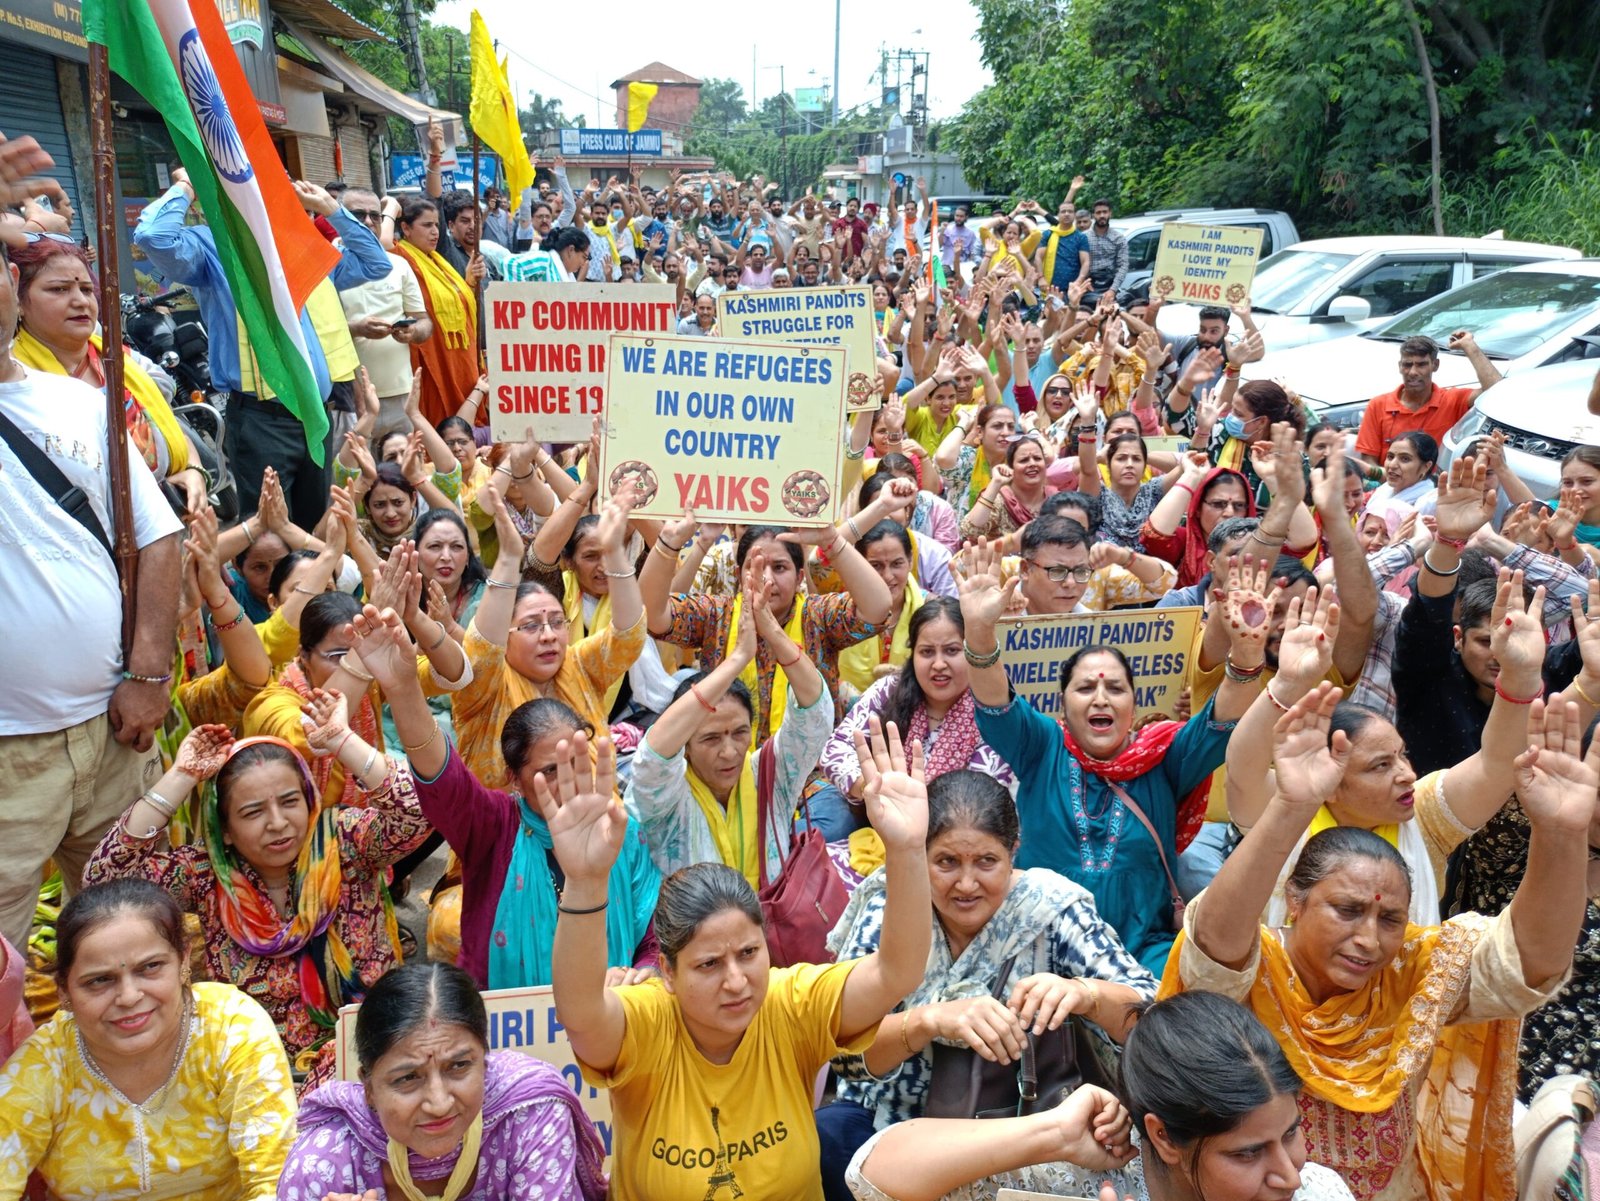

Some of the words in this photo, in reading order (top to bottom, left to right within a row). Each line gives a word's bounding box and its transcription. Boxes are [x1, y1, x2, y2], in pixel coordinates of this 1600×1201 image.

[25, 17, 63, 40] EXHIBITION
[580, 134, 603, 151] PRESS
[604, 134, 624, 151] CLUB
[624, 134, 634, 151] OF
[635, 134, 661, 152] JAMMU
[396, 169, 416, 187] OFFICE
[414, 165, 424, 177] OF
[465, 167, 493, 187] MAAGER
[1201, 229, 1206, 239] I
[1207, 231, 1222, 240] AM
[1167, 240, 1213, 252] KASHMIRI
[1214, 243, 1255, 256] PANDITS
[1182, 254, 1187, 263] I
[1188, 254, 1213, 266] LOVE
[1216, 257, 1232, 267] MY
[1184, 267, 1227, 280] IDENTITY
[1181, 281, 1221, 300] YAIKS
[726, 296, 800, 315] KASHMIRI
[805, 293, 866, 310] PANDITS
[493, 301, 526, 330] KP
[742, 317, 822, 336] STRUGGLE
[826, 315, 854, 330] FOR
[501, 344, 582, 372] LIVING
[622, 346, 655, 375] WE
[663, 349, 707, 378] ARE
[715, 353, 832, 385] REFUGEES
[498, 385, 570, 414] SINCE
[656, 389, 679, 417] IN
[687, 391, 734, 421] OUR
[742, 395, 794, 423] OWN
[664, 428, 781, 460] COUNTRY
[674, 472, 770, 513] YAIKS
[791, 490, 816, 498] YAIKS
[1005, 624, 1095, 651] KASHMIRI
[1100, 619, 1175, 645] PANDITS
[652, 1137, 716, 1169] GOGO
[727, 1121, 788, 1164] PARIS
